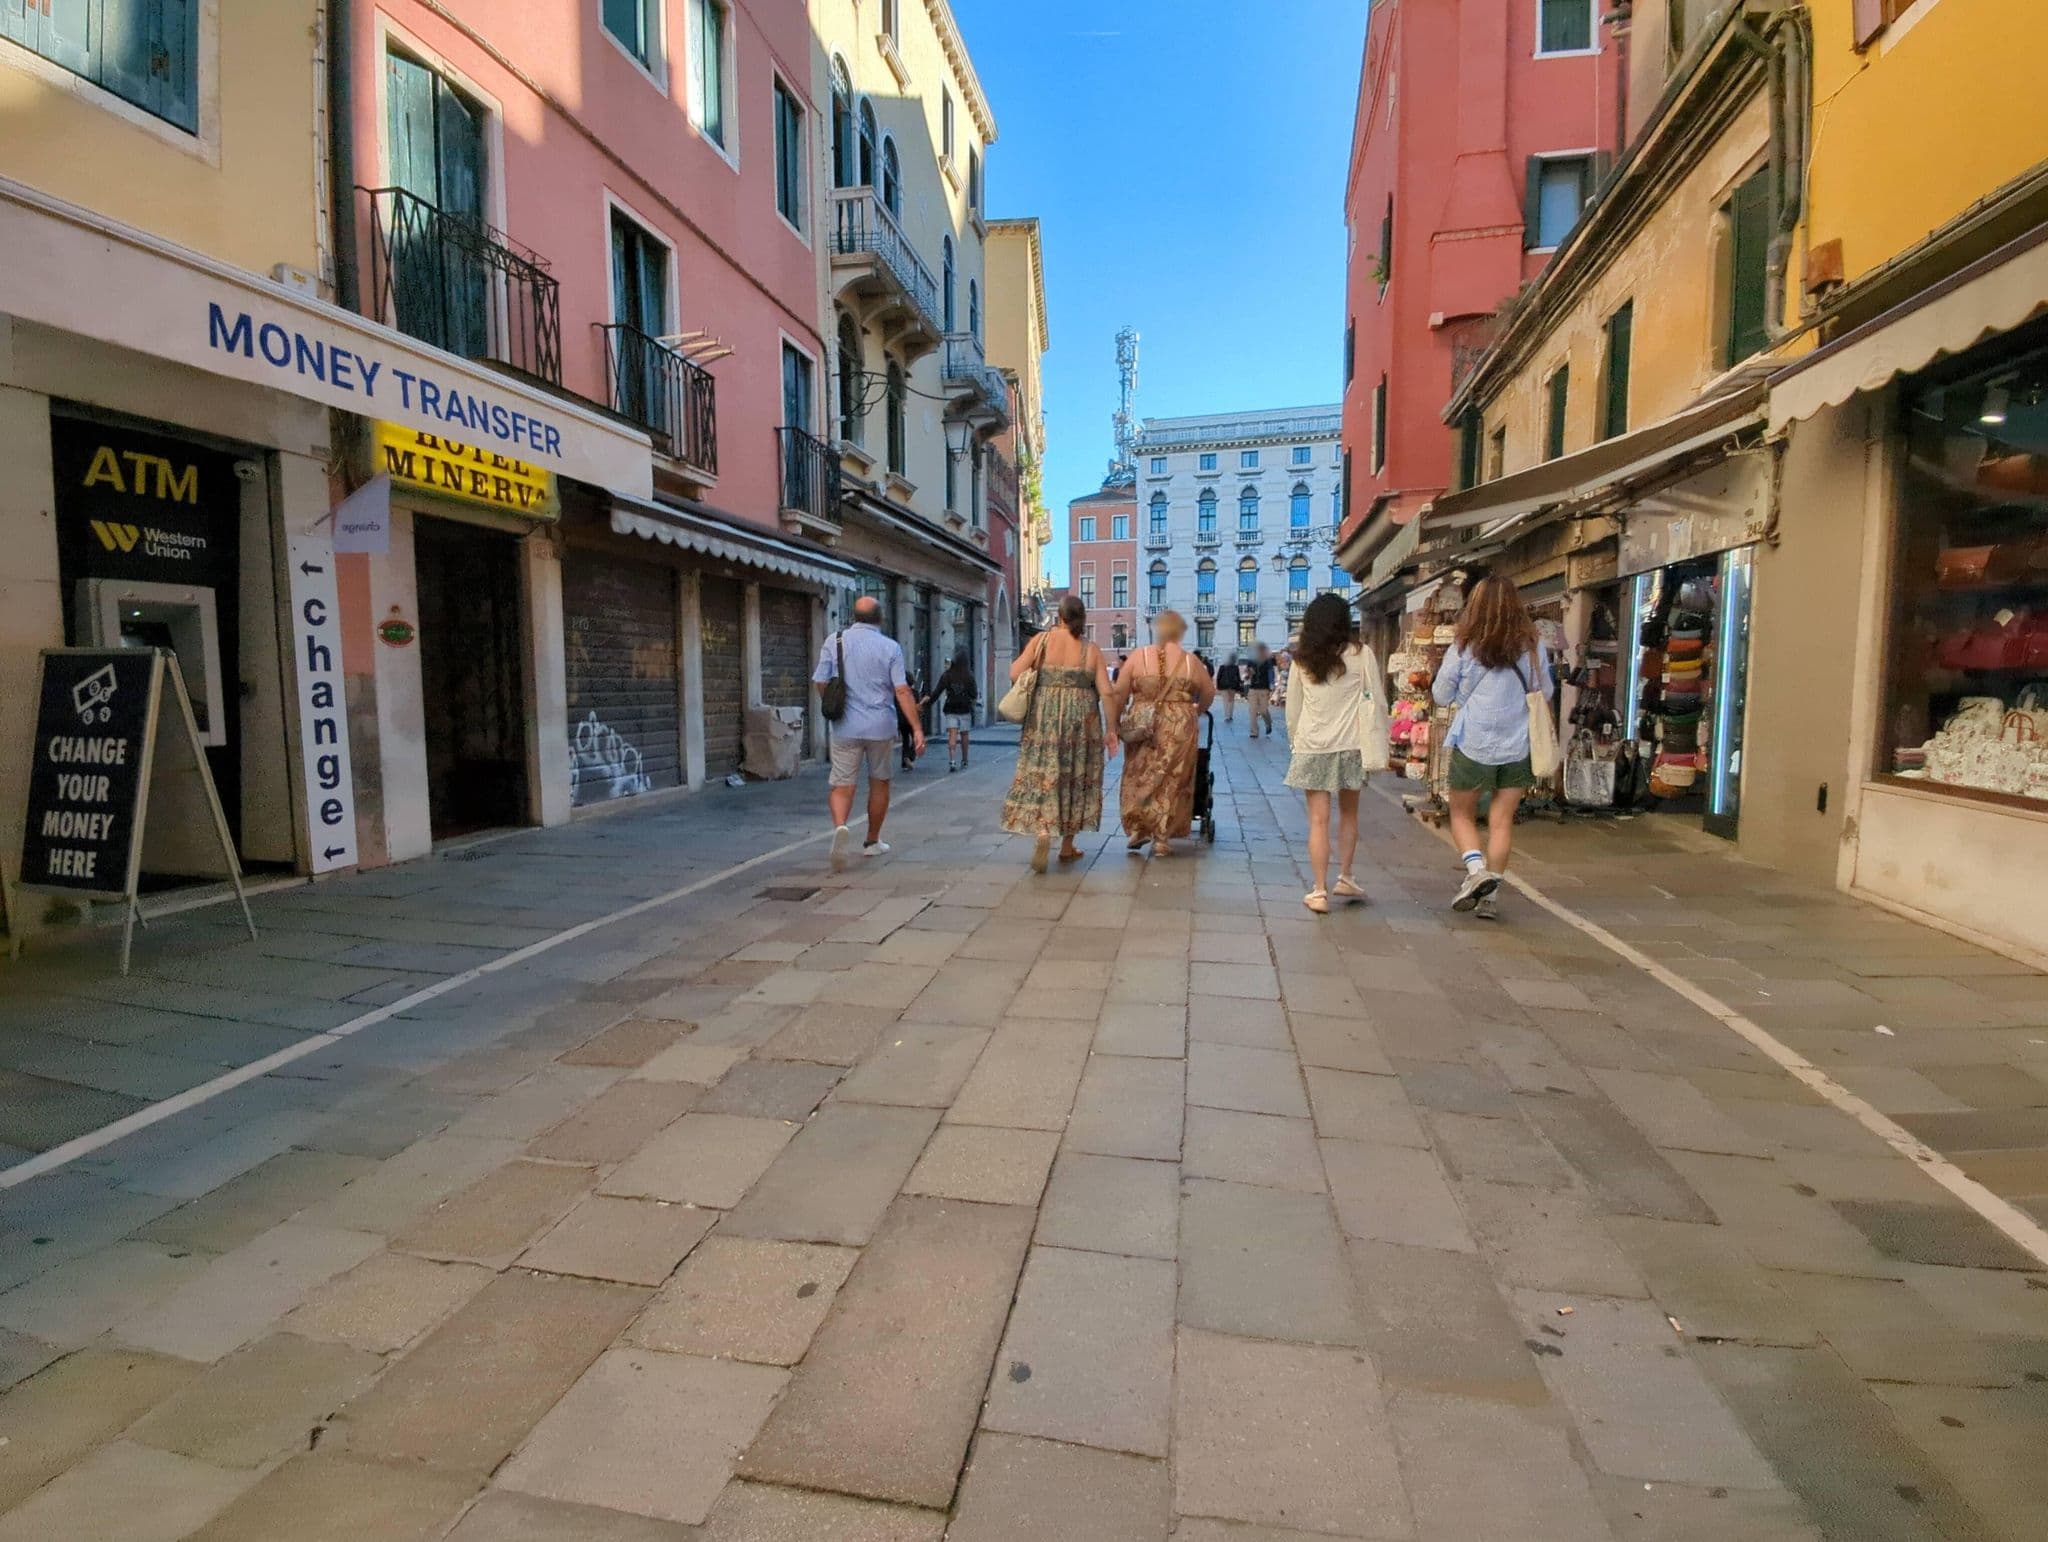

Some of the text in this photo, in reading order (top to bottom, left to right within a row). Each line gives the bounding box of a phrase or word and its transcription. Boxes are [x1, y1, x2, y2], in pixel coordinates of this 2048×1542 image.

[209, 302, 562, 458] MONEY TRANSFER
[82, 445, 199, 505] ATM
[144, 526, 207, 549] Western
[145, 542, 191, 560] Union
[303, 598, 343, 825] change
[48, 735, 128, 765] CHANGE
[57, 773, 110, 802] YOUR
[42, 810, 114, 841] MONEY
[49, 848, 97, 878] HERE
